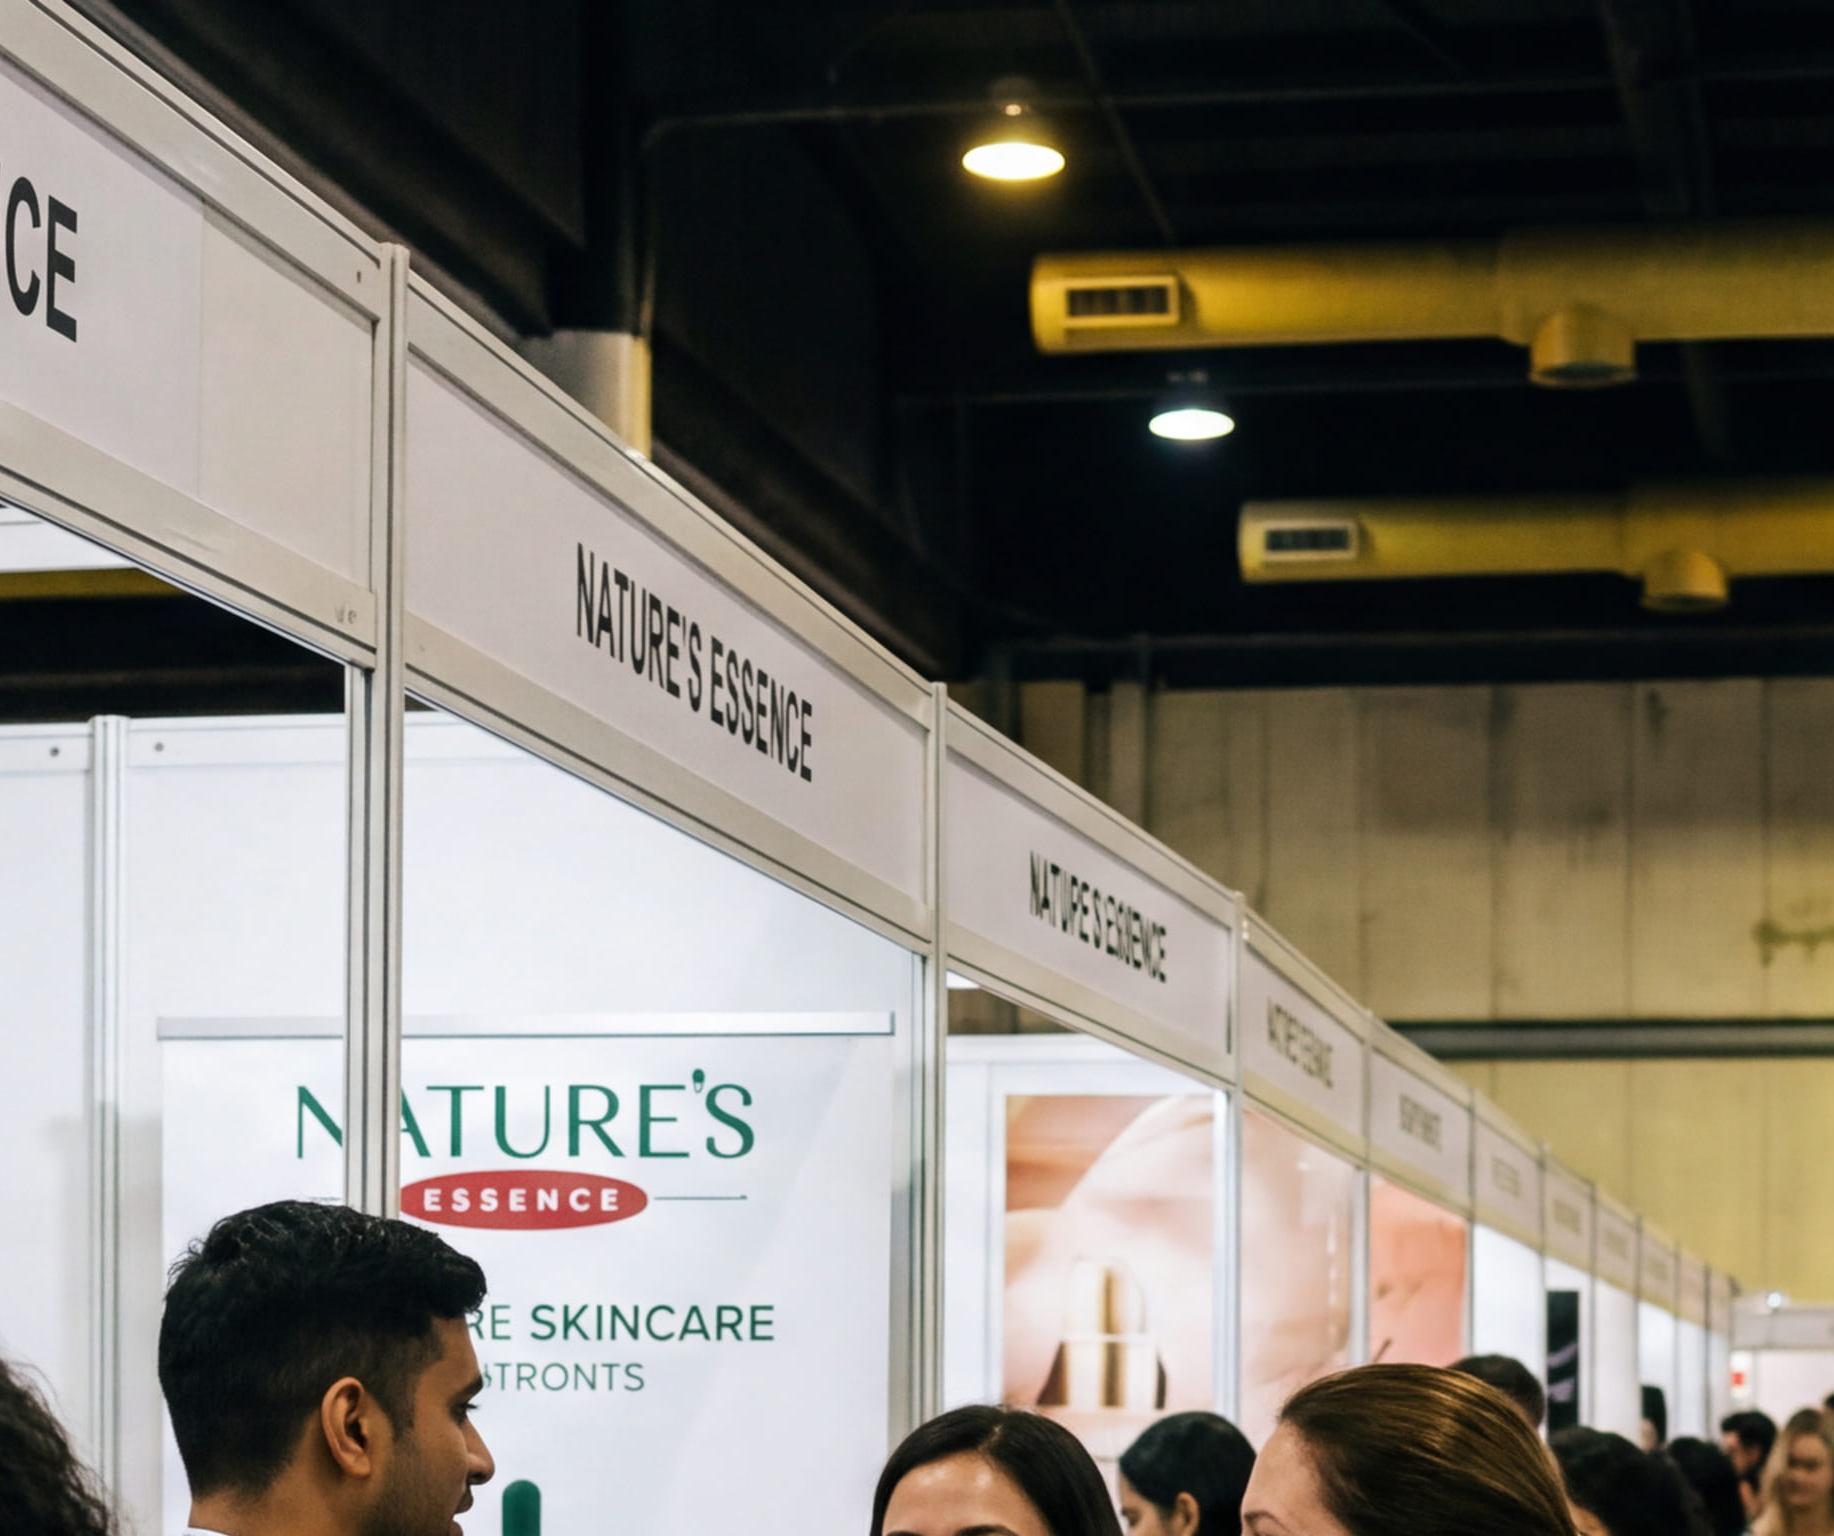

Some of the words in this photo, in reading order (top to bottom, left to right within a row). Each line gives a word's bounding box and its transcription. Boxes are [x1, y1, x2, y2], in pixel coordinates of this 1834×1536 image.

[576, 541, 703, 714] NATURE'S
[709, 634, 813, 783] ESSENCE
[423, 1187, 621, 1213] ESSENCE
[530, 1303, 776, 1342] SKINCARE
[484, 1362, 645, 1392] TRONTS
